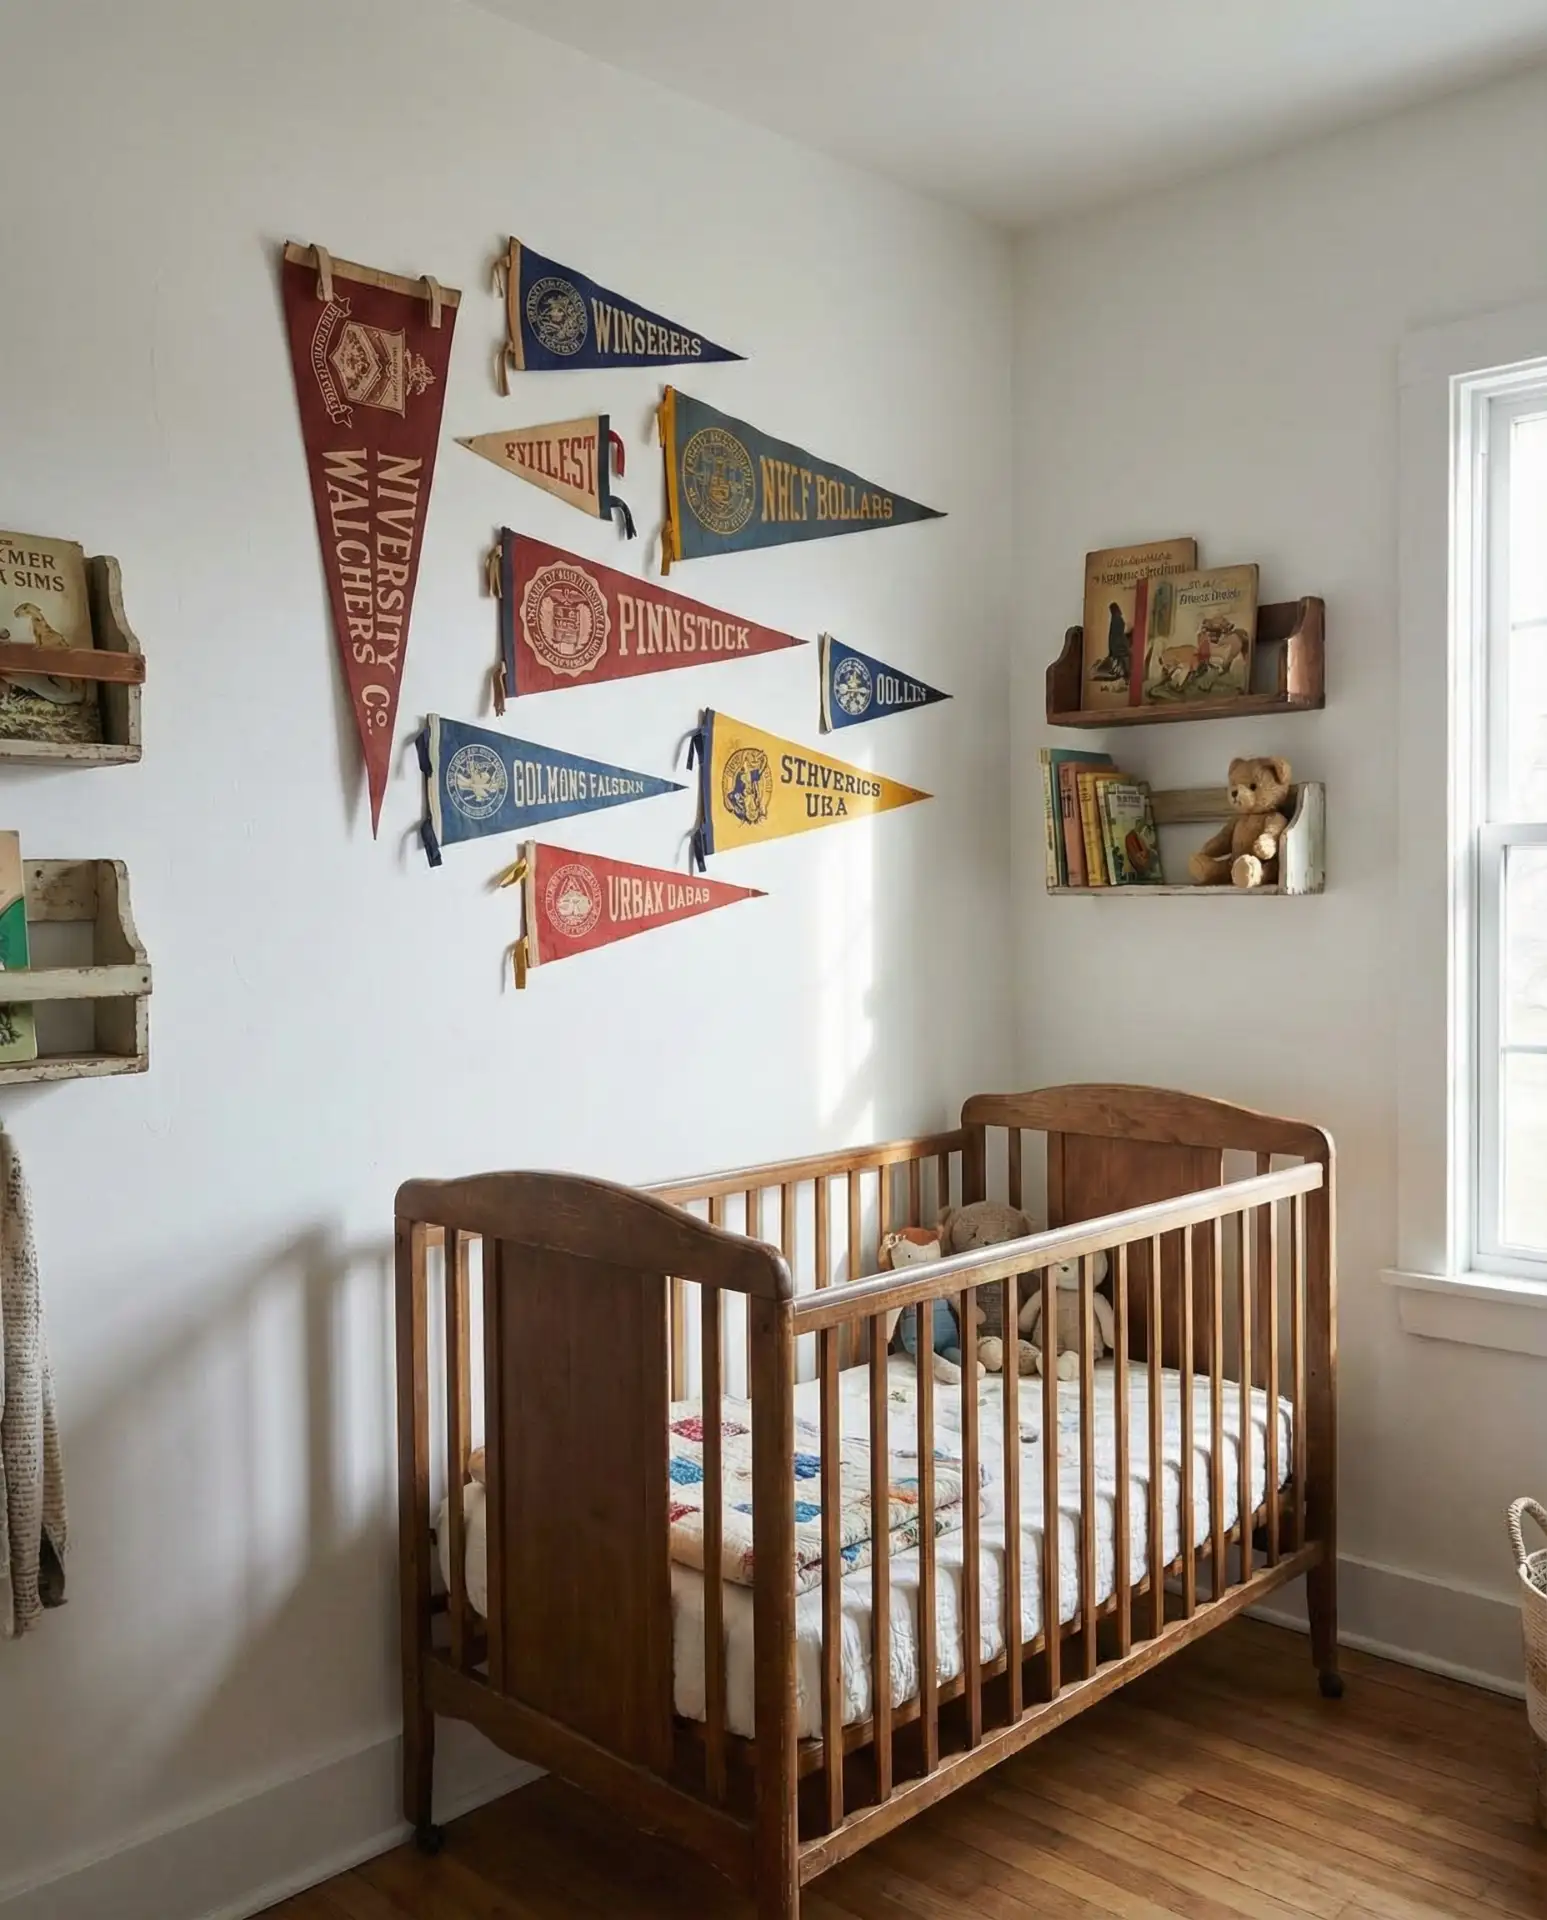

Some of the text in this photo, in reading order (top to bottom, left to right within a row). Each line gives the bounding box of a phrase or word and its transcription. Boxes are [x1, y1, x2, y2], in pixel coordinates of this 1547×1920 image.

[591, 297, 702, 356] WINSERERS
[14, 570, 65, 592] SIMS
[322, 447, 376, 665] WALCHERS
[376, 451, 423, 674] NIVERSITY
[617, 592, 750, 656] PINNSTOCK
